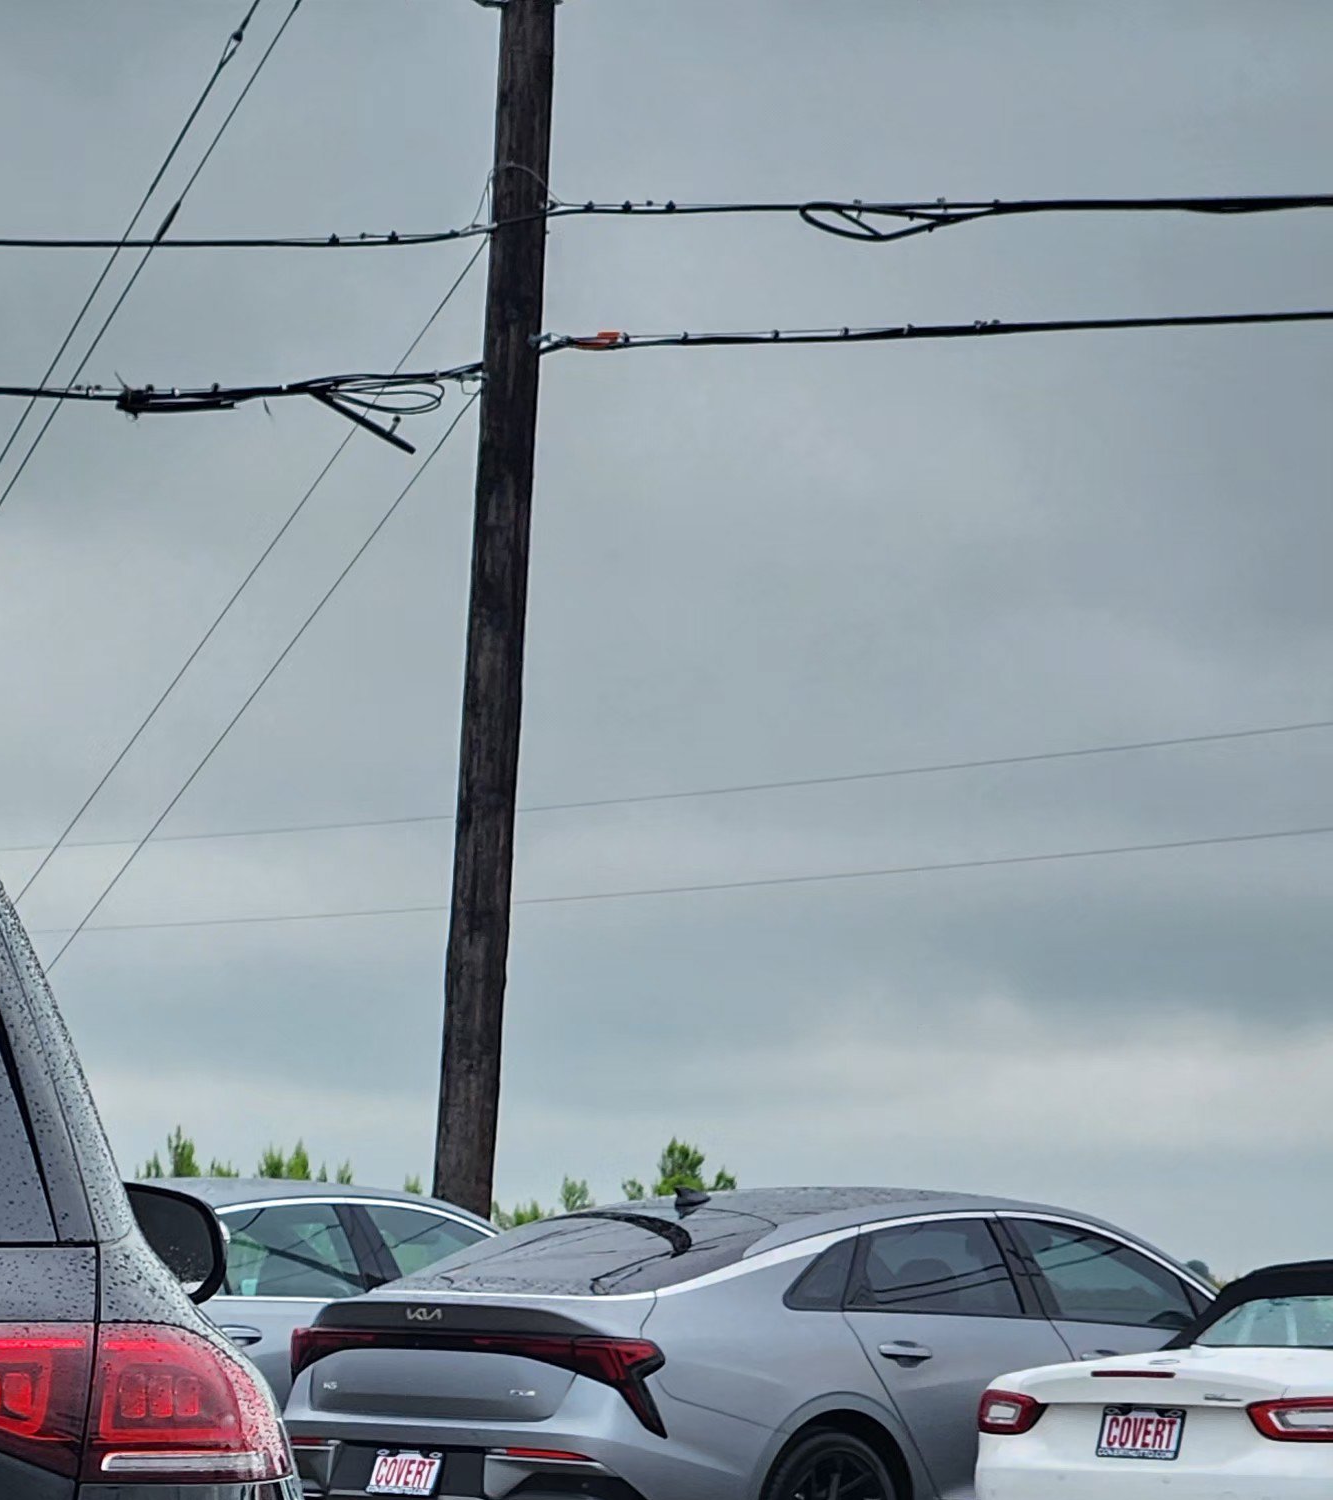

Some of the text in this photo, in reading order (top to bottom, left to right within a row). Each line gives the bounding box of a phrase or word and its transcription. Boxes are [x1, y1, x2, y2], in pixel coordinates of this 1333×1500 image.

[405, 1307, 443, 1321] KIA
[1106, 1416, 1177, 1449] COVERT
[375, 1457, 436, 1489] COVERT
